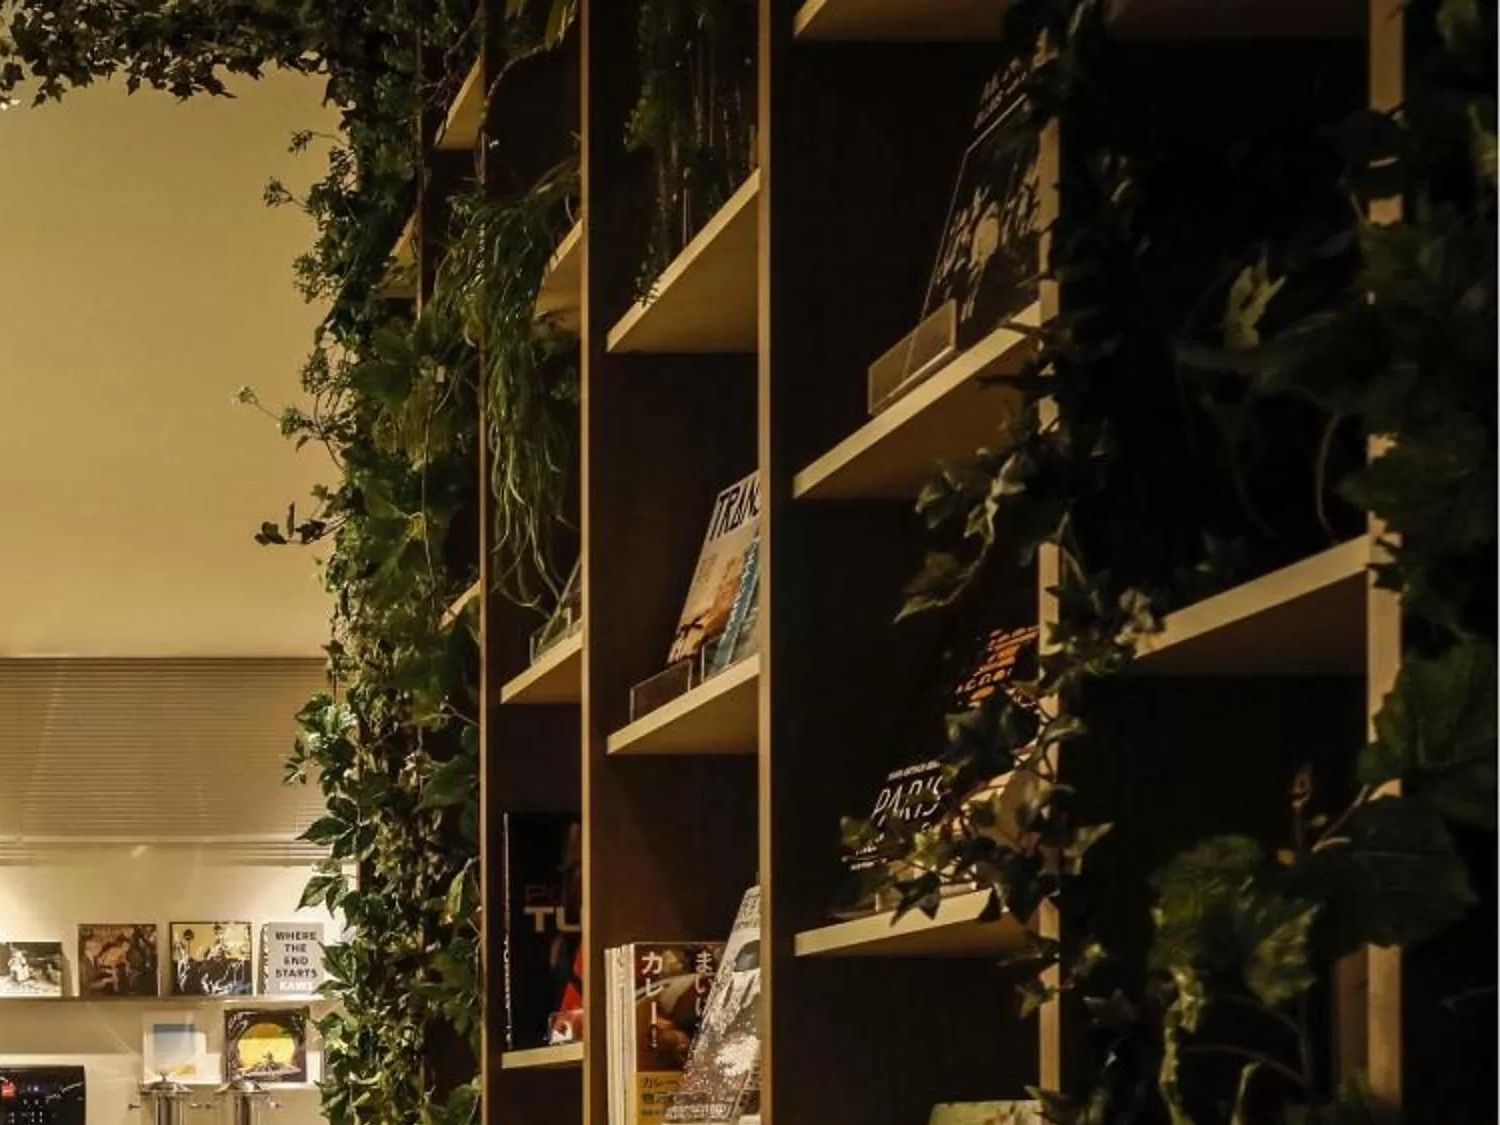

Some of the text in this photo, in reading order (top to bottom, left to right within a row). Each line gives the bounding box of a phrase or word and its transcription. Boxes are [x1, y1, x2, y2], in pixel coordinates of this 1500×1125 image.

[275, 931, 317, 941] WHERE
[283, 943, 307, 953] THE
[283, 956, 309, 966] END
[275, 968, 319, 979] STARTS
